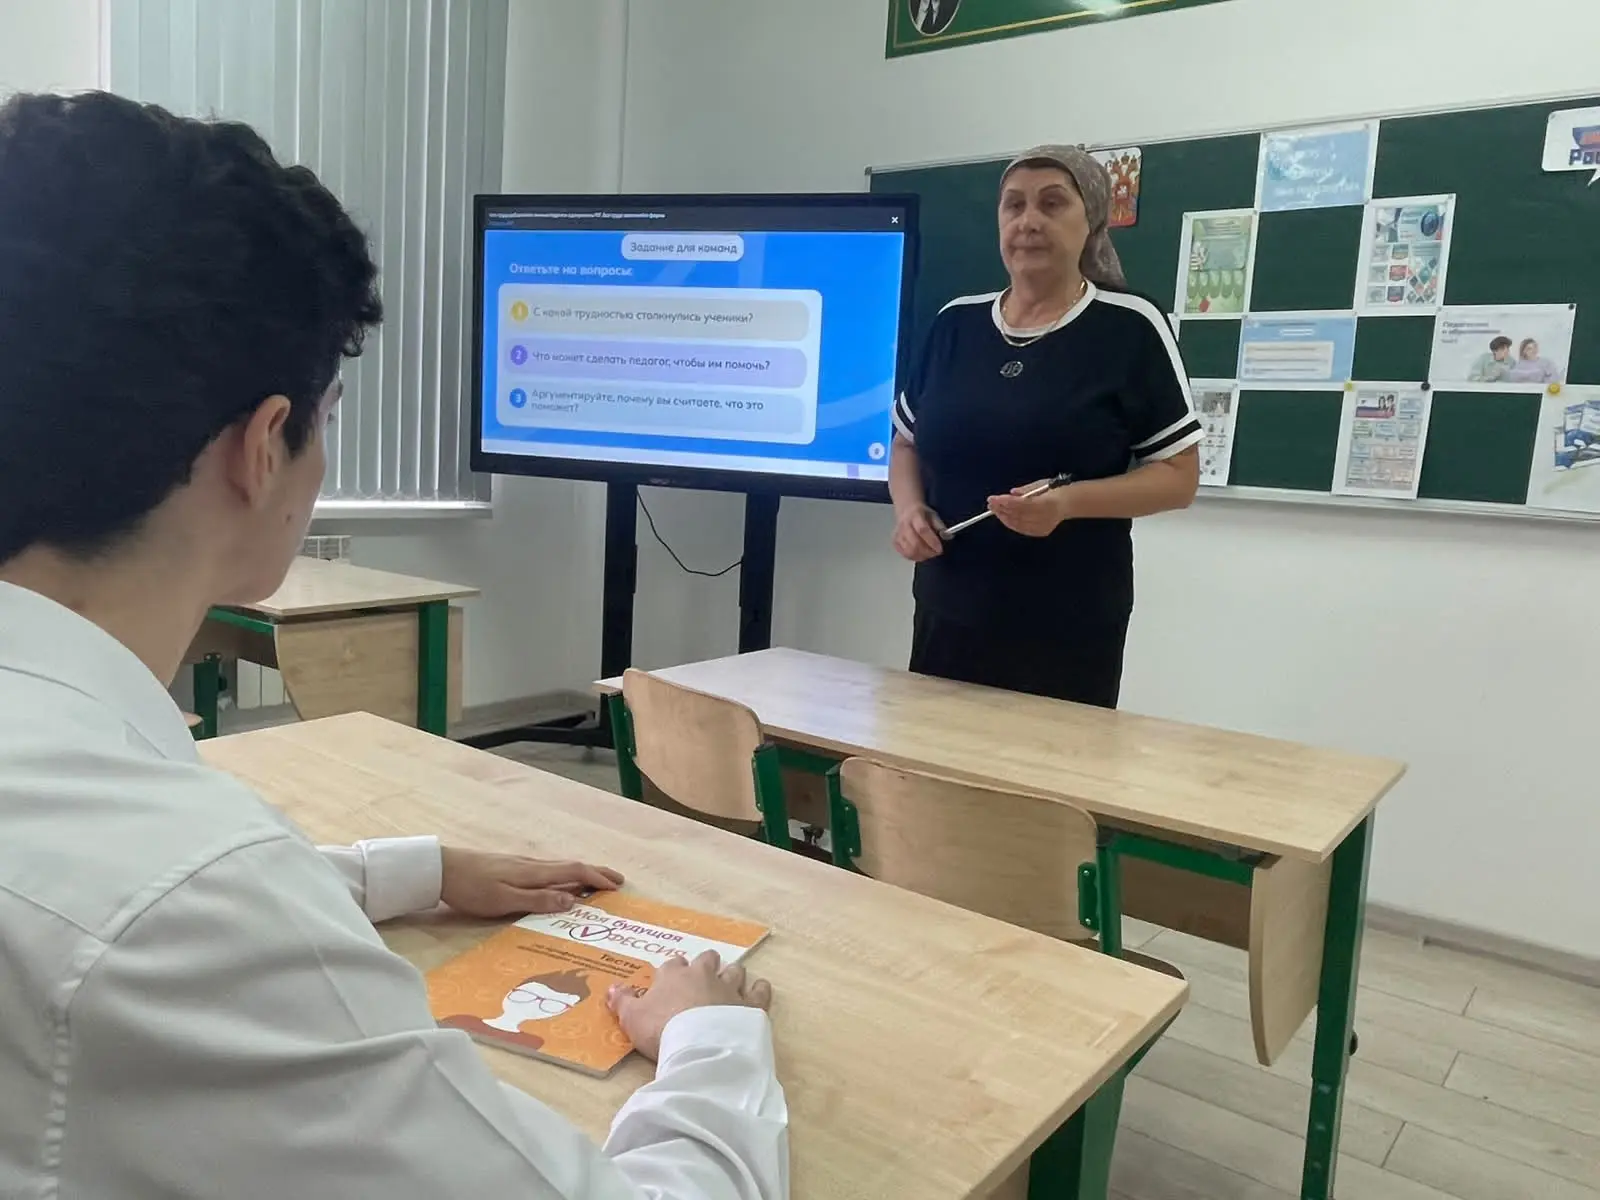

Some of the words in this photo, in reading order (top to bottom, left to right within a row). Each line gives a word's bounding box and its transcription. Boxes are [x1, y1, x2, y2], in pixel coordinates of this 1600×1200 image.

[1568, 148, 1600, 166] Ро
[630, 242, 673, 253] Задание
[676, 243, 696, 254] для
[698, 243, 738, 255] команд
[509, 263, 560, 275] Ответьте
[563, 265, 578, 275] на
[542, 307, 572, 318] какой
[575, 309, 634, 321] трудностью
[636, 311, 702, 323] столкнулись
[703, 312, 754, 325] ученики?
[532, 351, 551, 361] Что
[552, 353, 585, 363] может
[586, 355, 627, 366] сделать
[629, 357, 671, 368] педагог,
[673, 357, 706, 368] чтобы
[708, 360, 723, 369] им
[725, 360, 770, 371] помочь?
[617, 394, 654, 406] почему
[656, 397, 672, 406] вы
[725, 401, 744, 409] что
[745, 402, 764, 411] это
[569, 908, 609, 924] Моя
[612, 919, 683, 943] будущая
[600, 953, 642, 970] Тесты
